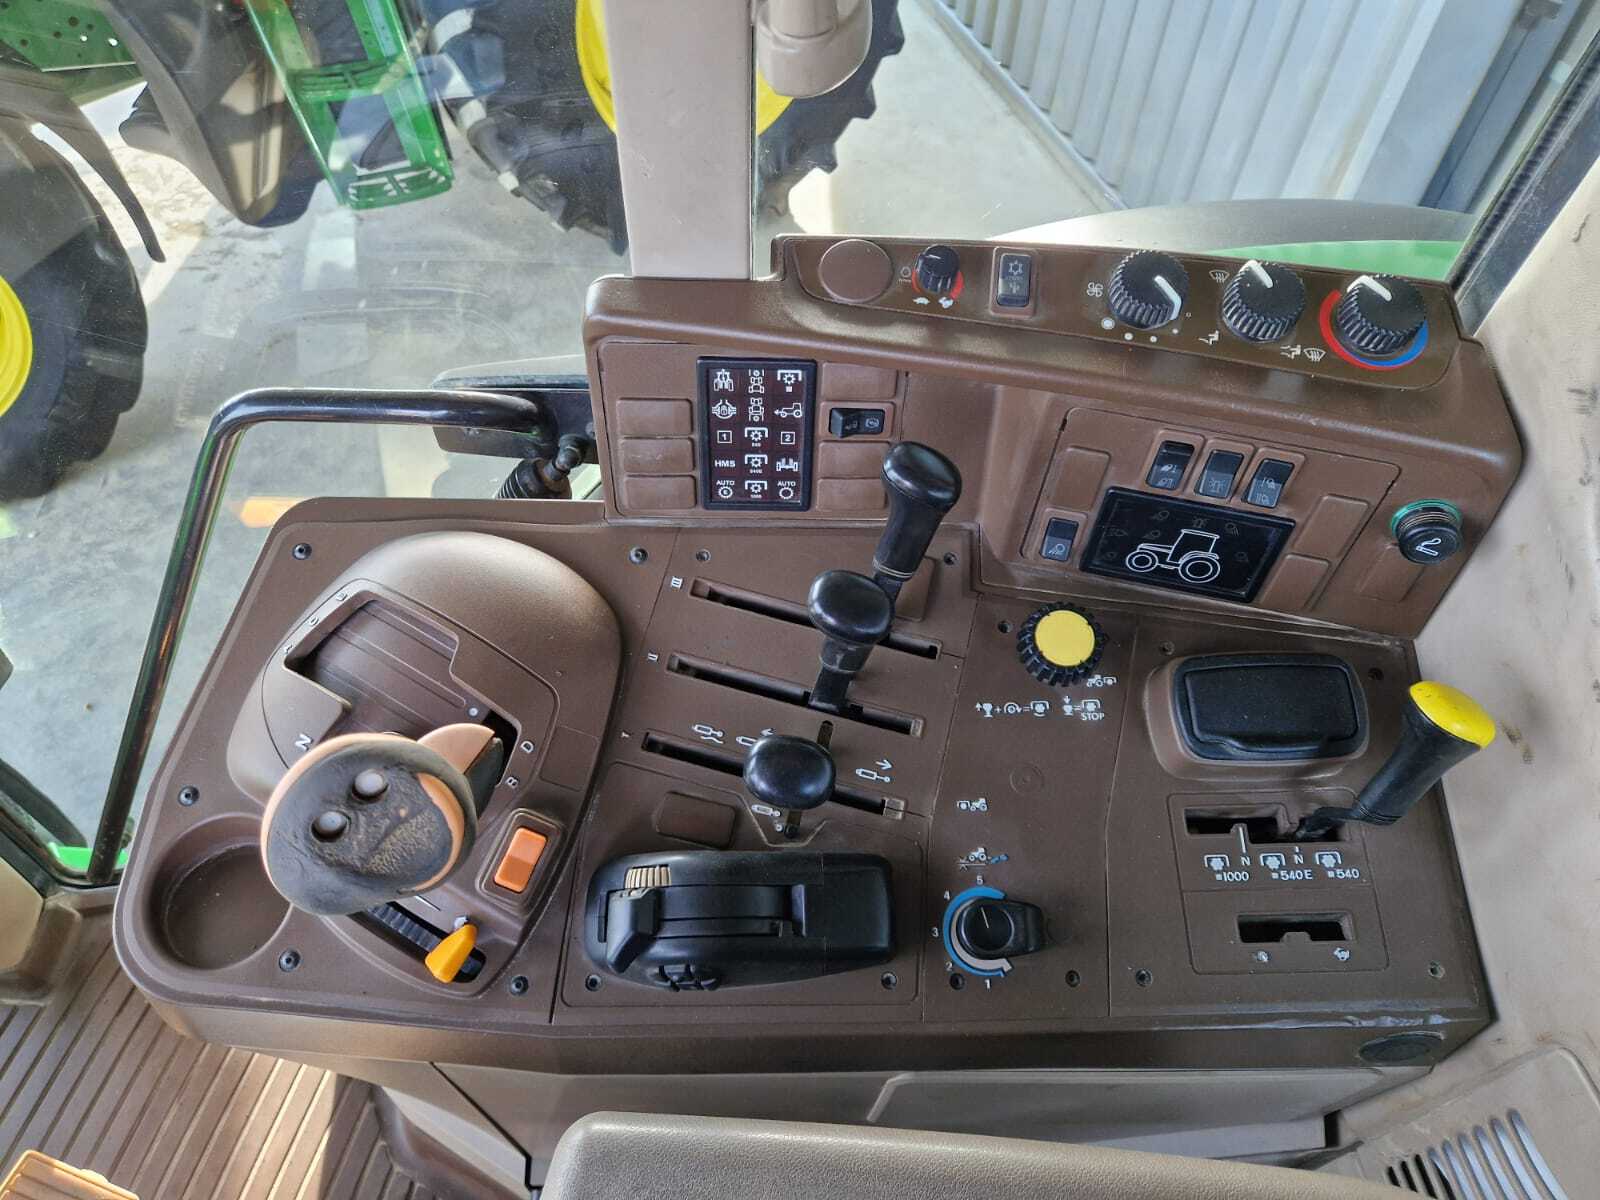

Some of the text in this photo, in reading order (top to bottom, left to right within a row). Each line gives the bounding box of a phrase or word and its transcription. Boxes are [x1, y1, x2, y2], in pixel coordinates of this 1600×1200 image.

[721, 433, 728, 441] 1
[784, 434, 791, 442] 2
[714, 459, 736, 468] HMS
[1080, 712, 1105, 721] STOP
[295, 733, 312, 750] N
[520, 740, 534, 753] D
[1241, 856, 1251, 866] N
[1295, 854, 1304, 864] N
[1222, 871, 1250, 882] 1000
[1337, 868, 1360, 879] 540
[976, 875, 984, 885] 5
[943, 890, 951, 900] 4
[931, 927, 939, 937] 3
[945, 961, 953, 971] 2
[984, 979, 991, 990] 1
